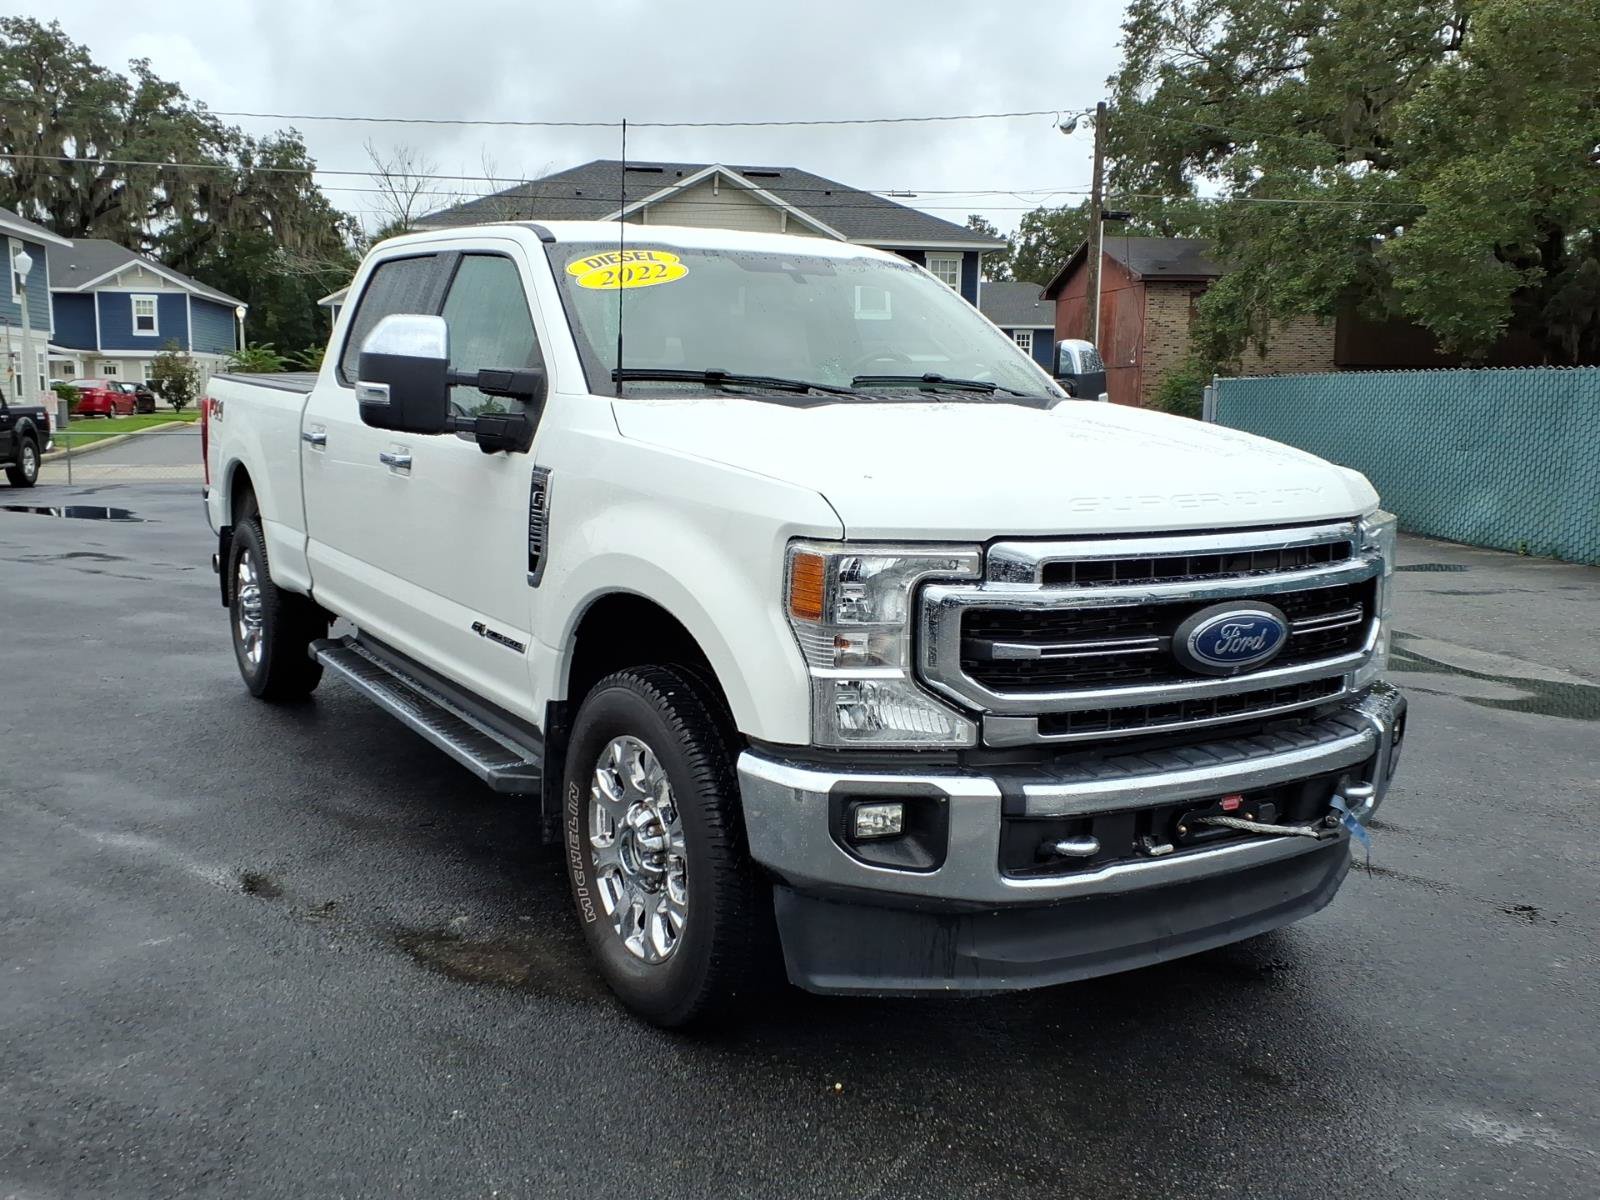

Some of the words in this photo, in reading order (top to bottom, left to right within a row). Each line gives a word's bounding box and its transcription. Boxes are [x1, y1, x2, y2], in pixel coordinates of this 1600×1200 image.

[584, 251, 659, 269] DIESEL
[601, 264, 668, 286] 2022
[1214, 622, 1268, 655] Ford
[568, 781, 597, 923] MICHELIN
